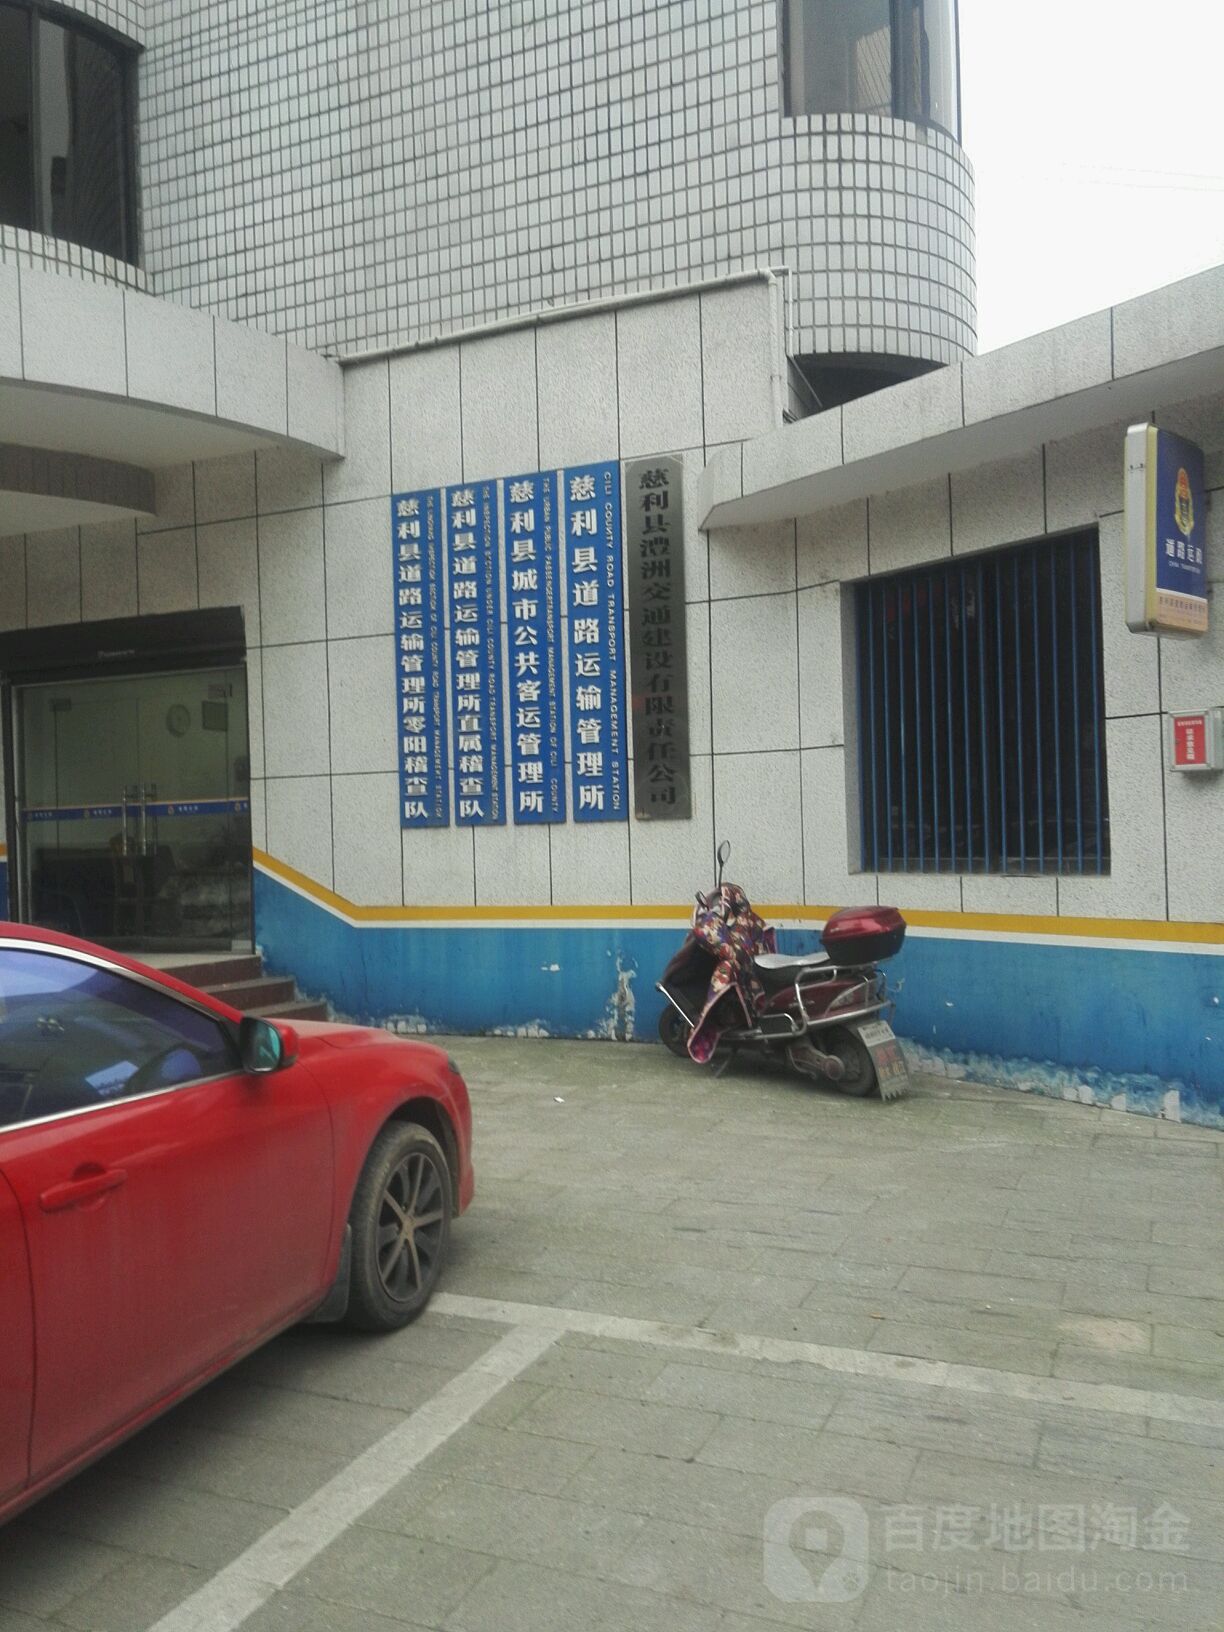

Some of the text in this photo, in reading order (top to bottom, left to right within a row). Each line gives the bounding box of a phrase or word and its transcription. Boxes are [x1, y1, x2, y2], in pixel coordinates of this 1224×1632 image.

[604, 471, 612, 495] CILI
[606, 555, 615, 588] ROAD
[397, 497, 429, 819] 慈利县道路运输管理所零阳稽查队
[451, 487, 484, 818] 慈利县道路运输管理所直属稽查队
[509, 480, 544, 813] 慈利县城市公共客运管理所
[569, 475, 605, 811] 慈利县道路运输管理所
[607, 593, 617, 661] TRANSPORT
[549, 701, 557, 733] STATION
[609, 669, 619, 754] MANAGEMENT
[551, 778, 559, 812] COUNTY
[611, 761, 621, 810] STATION
